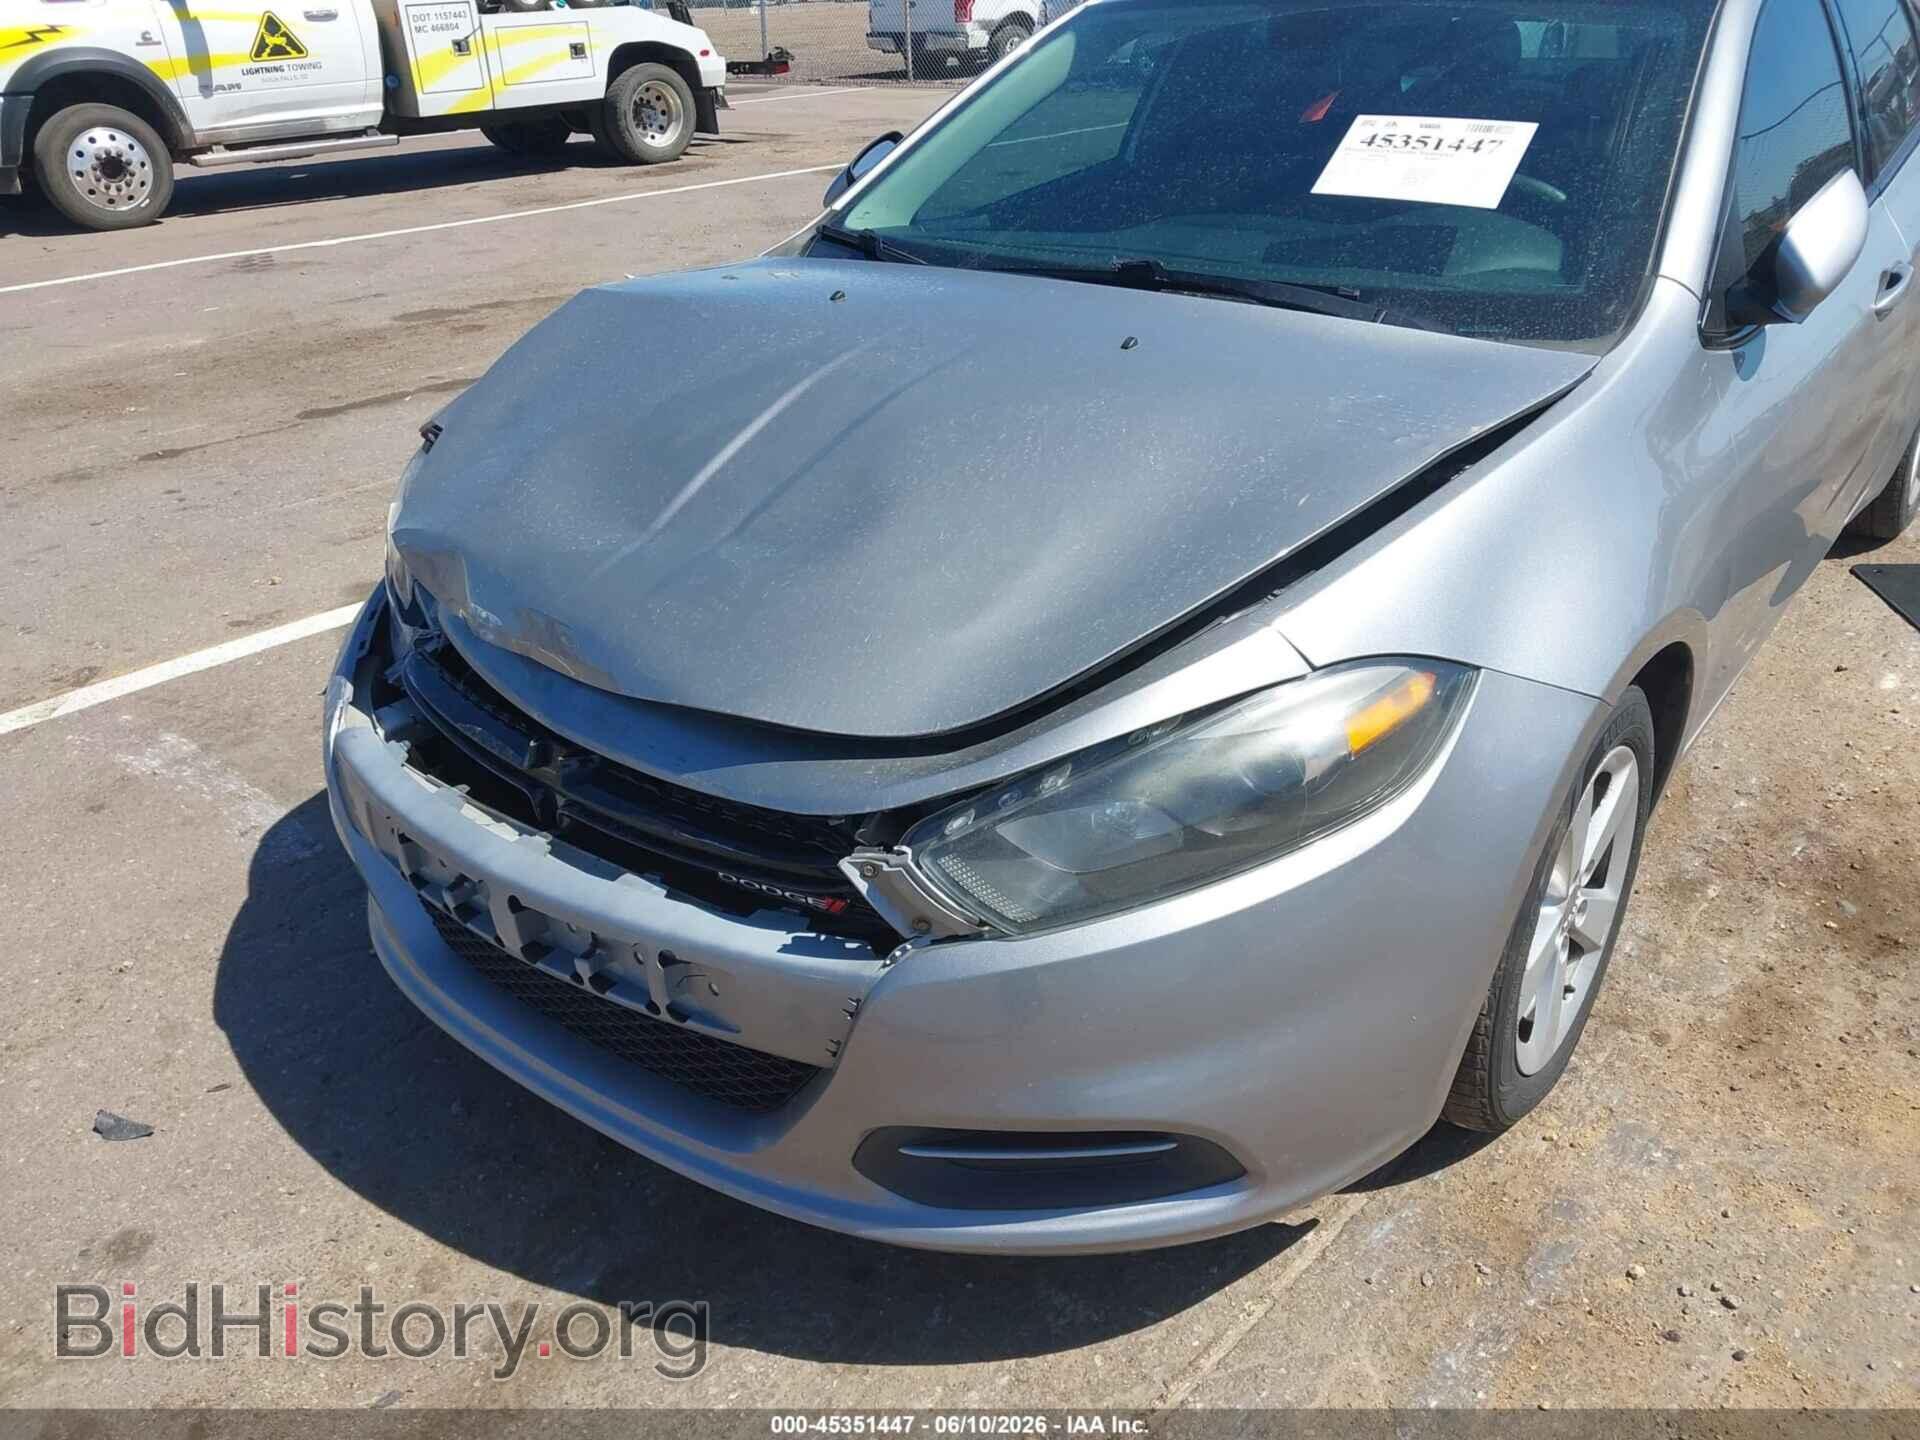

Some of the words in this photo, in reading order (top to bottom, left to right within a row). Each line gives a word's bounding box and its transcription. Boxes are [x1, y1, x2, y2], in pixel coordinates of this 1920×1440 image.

[411, 12, 431, 23] DOT
[414, 25, 428, 34] MC
[242, 65, 285, 76] LIGHTNING
[287, 61, 322, 72] TOWING
[718, 871, 827, 910] DODGE
